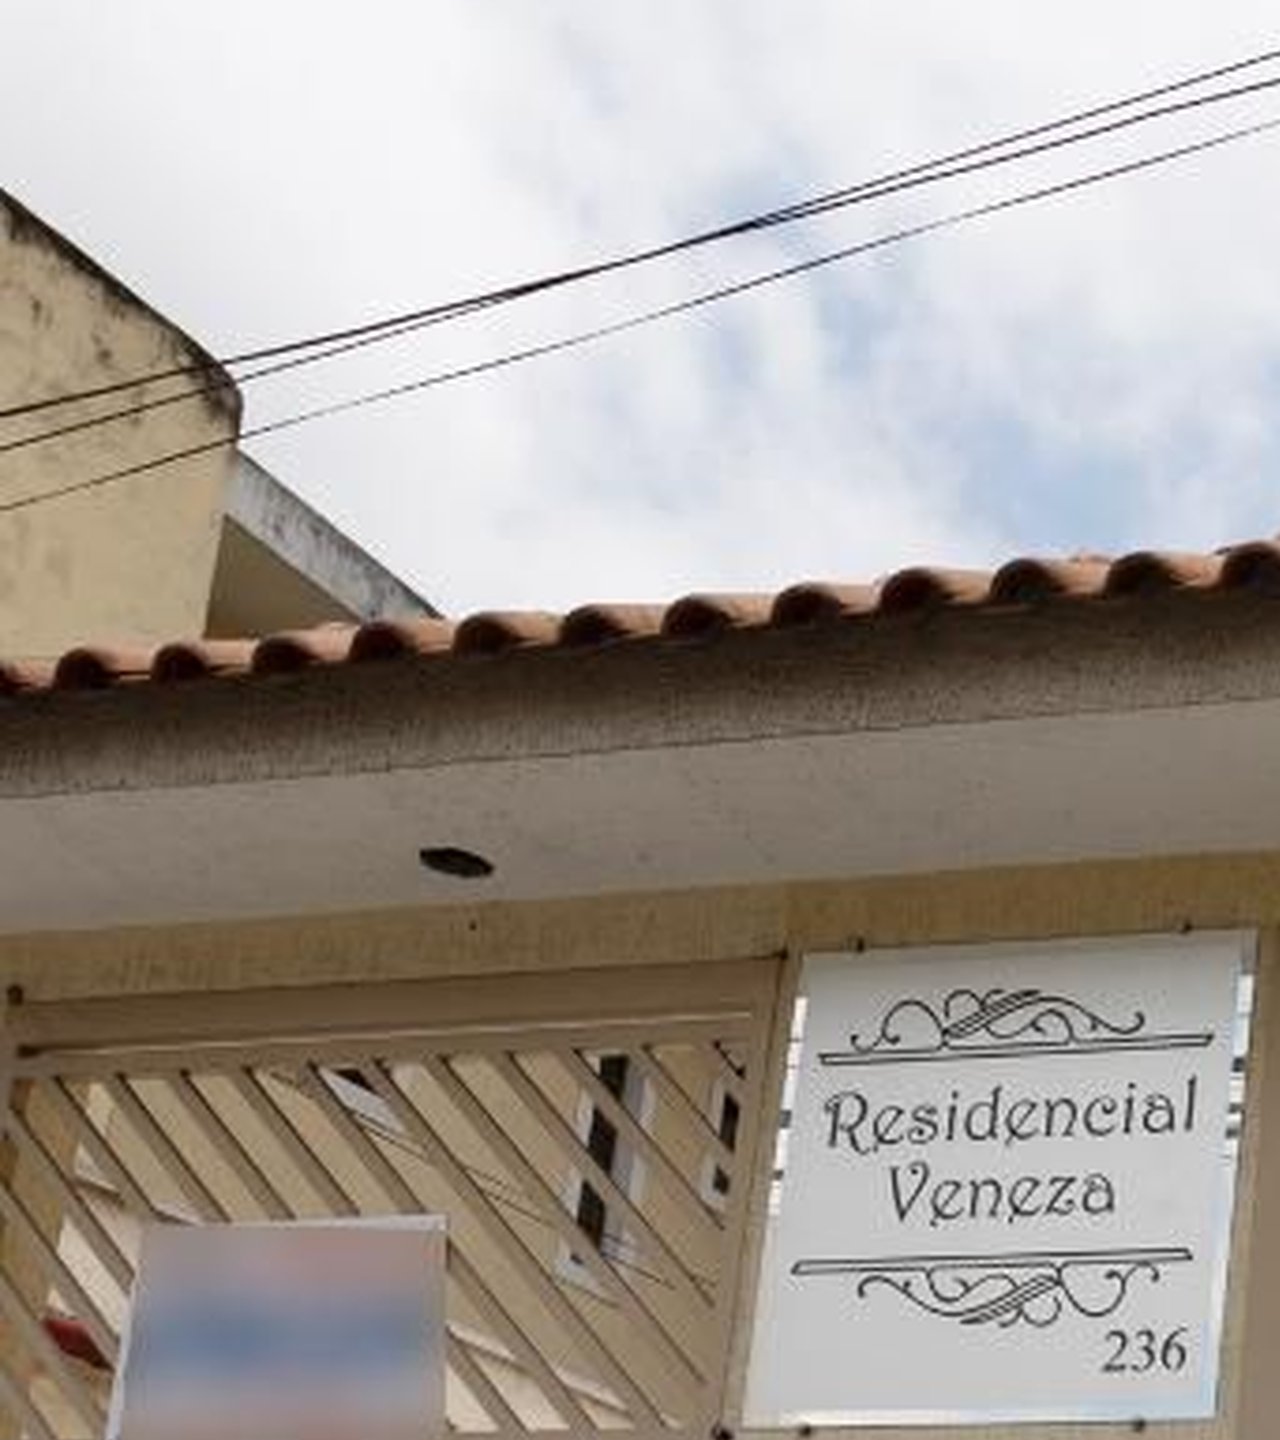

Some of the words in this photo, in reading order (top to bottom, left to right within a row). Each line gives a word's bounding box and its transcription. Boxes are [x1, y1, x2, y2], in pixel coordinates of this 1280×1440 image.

[823, 1075, 1197, 1156] Residencial
[889, 1161, 1115, 1228] Veneza
[1102, 1329, 1187, 1373] 236
